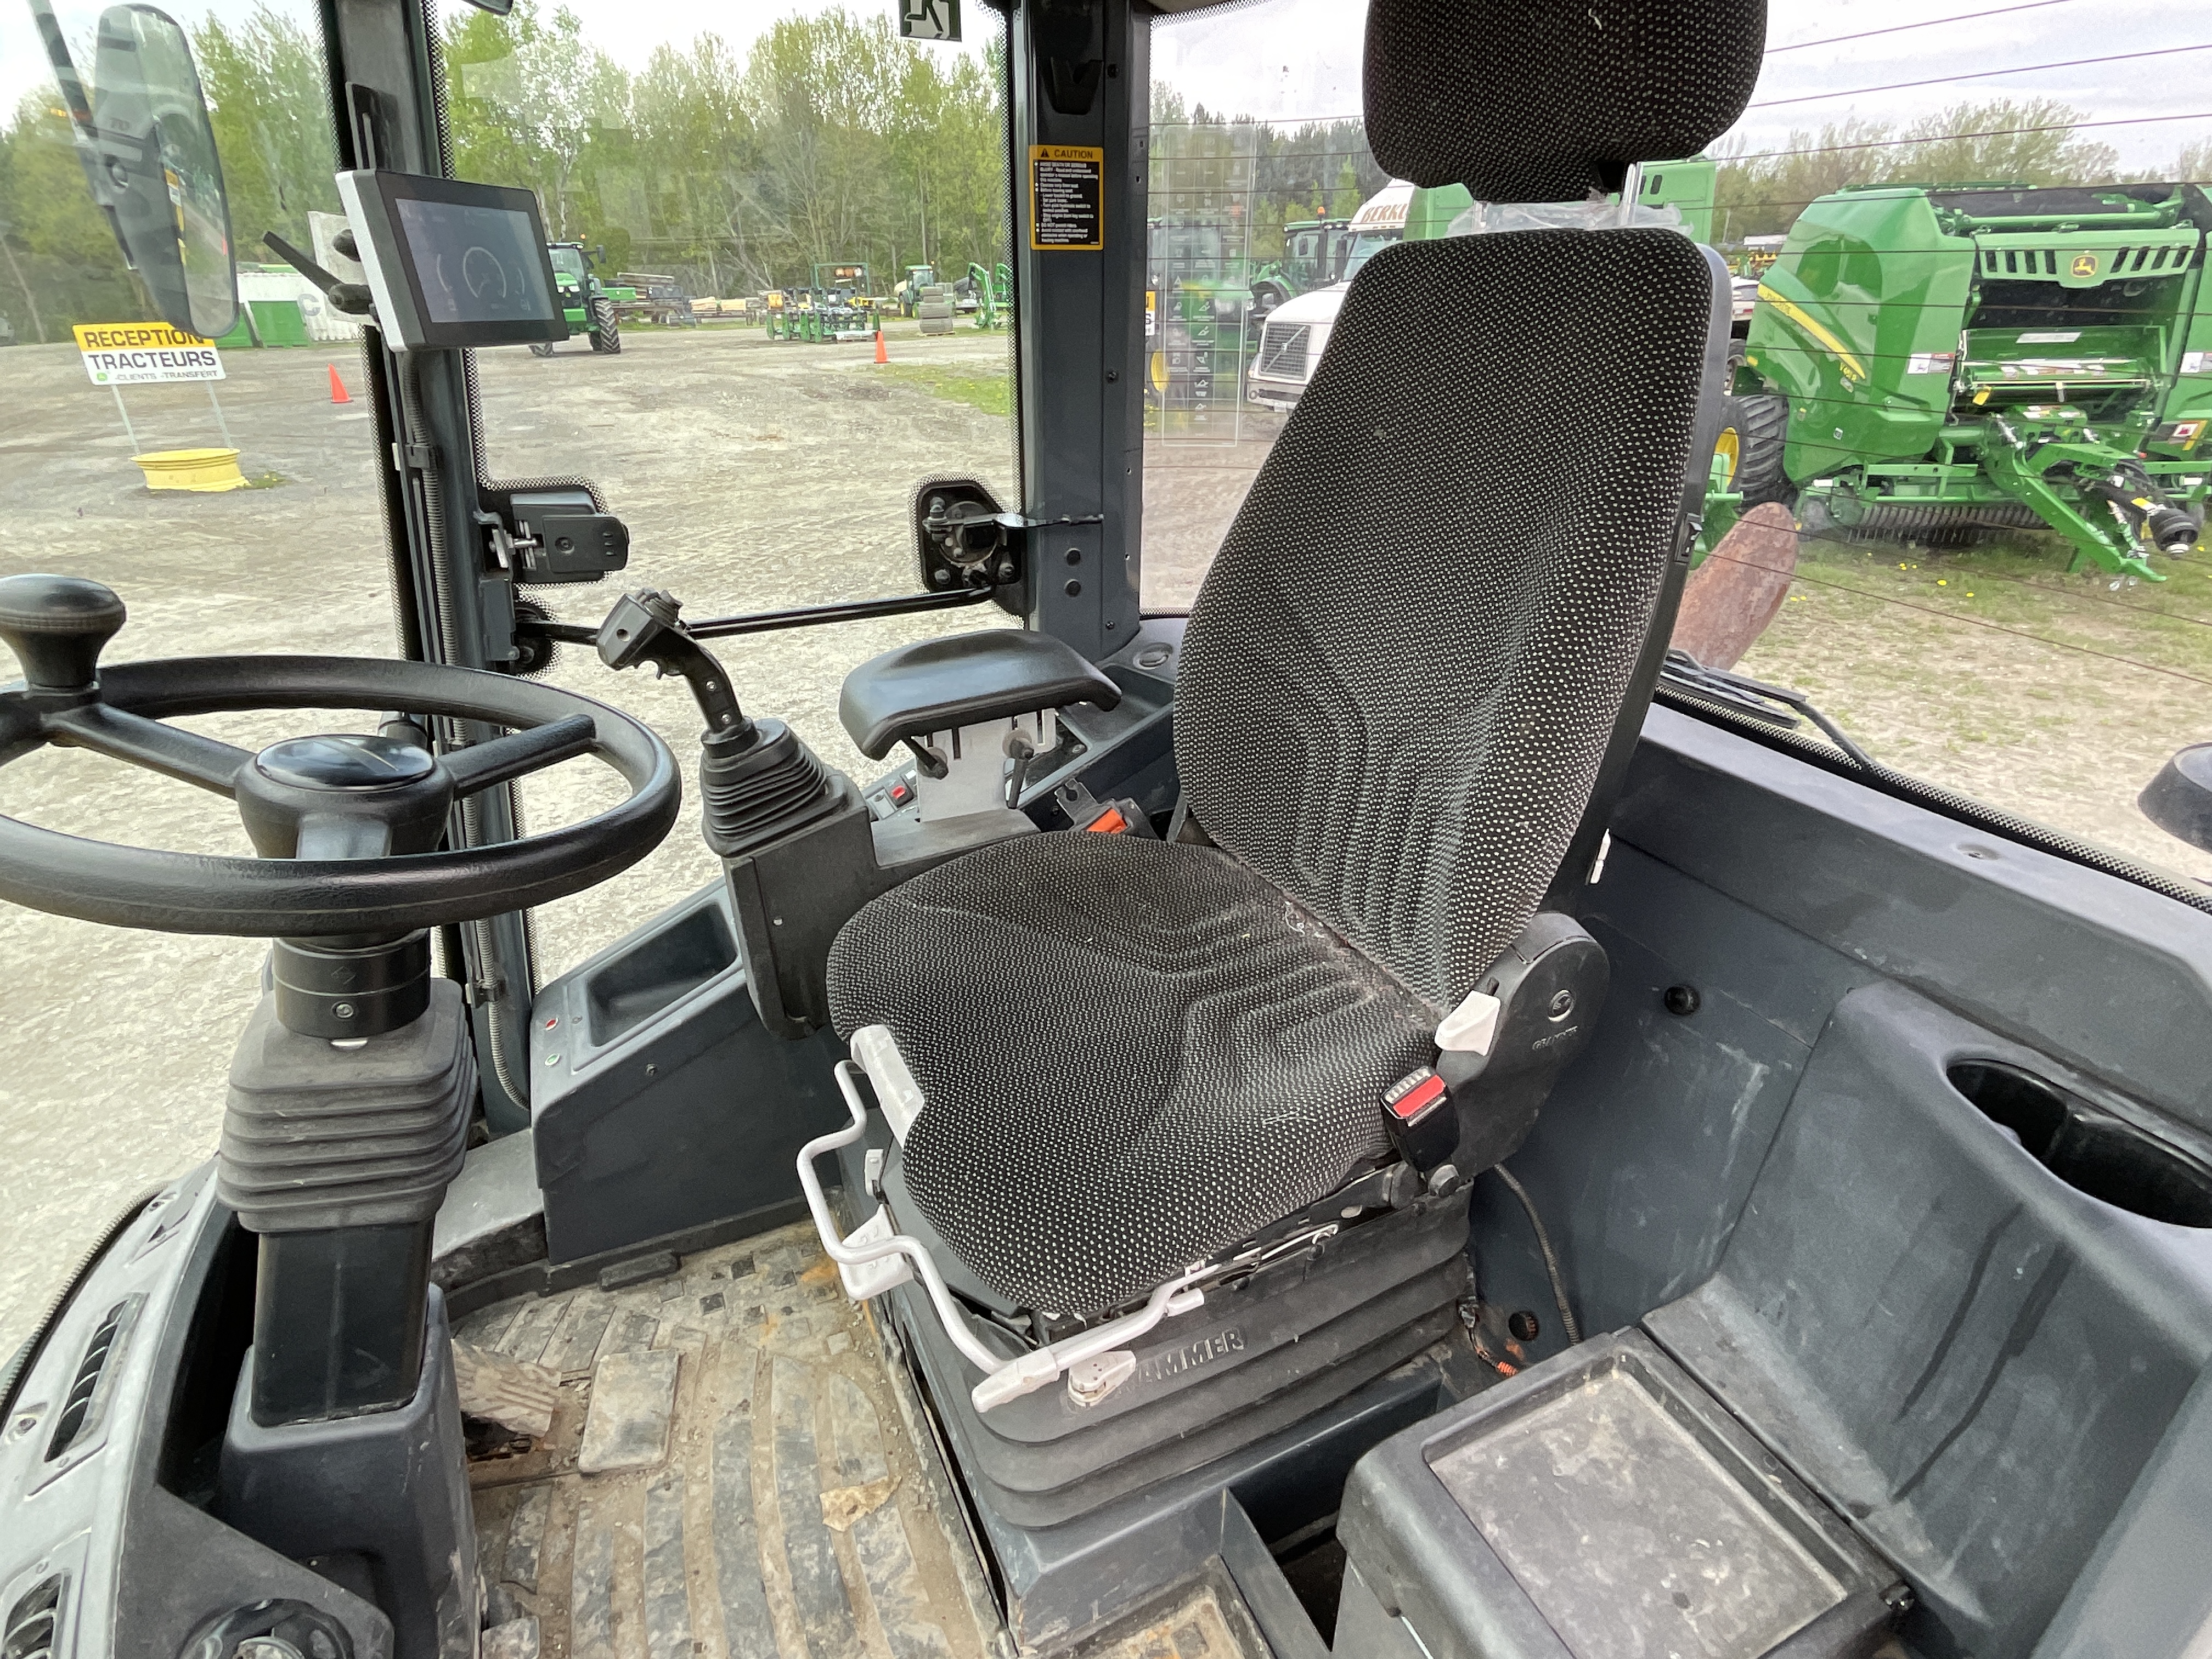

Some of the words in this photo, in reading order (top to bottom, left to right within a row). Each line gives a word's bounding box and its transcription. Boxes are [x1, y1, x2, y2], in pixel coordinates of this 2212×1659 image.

[1054, 149, 1093, 159] CAUTION
[88, 351, 216, 370] TRACTEURS
[1116, 1327, 1245, 1396] AMMER
